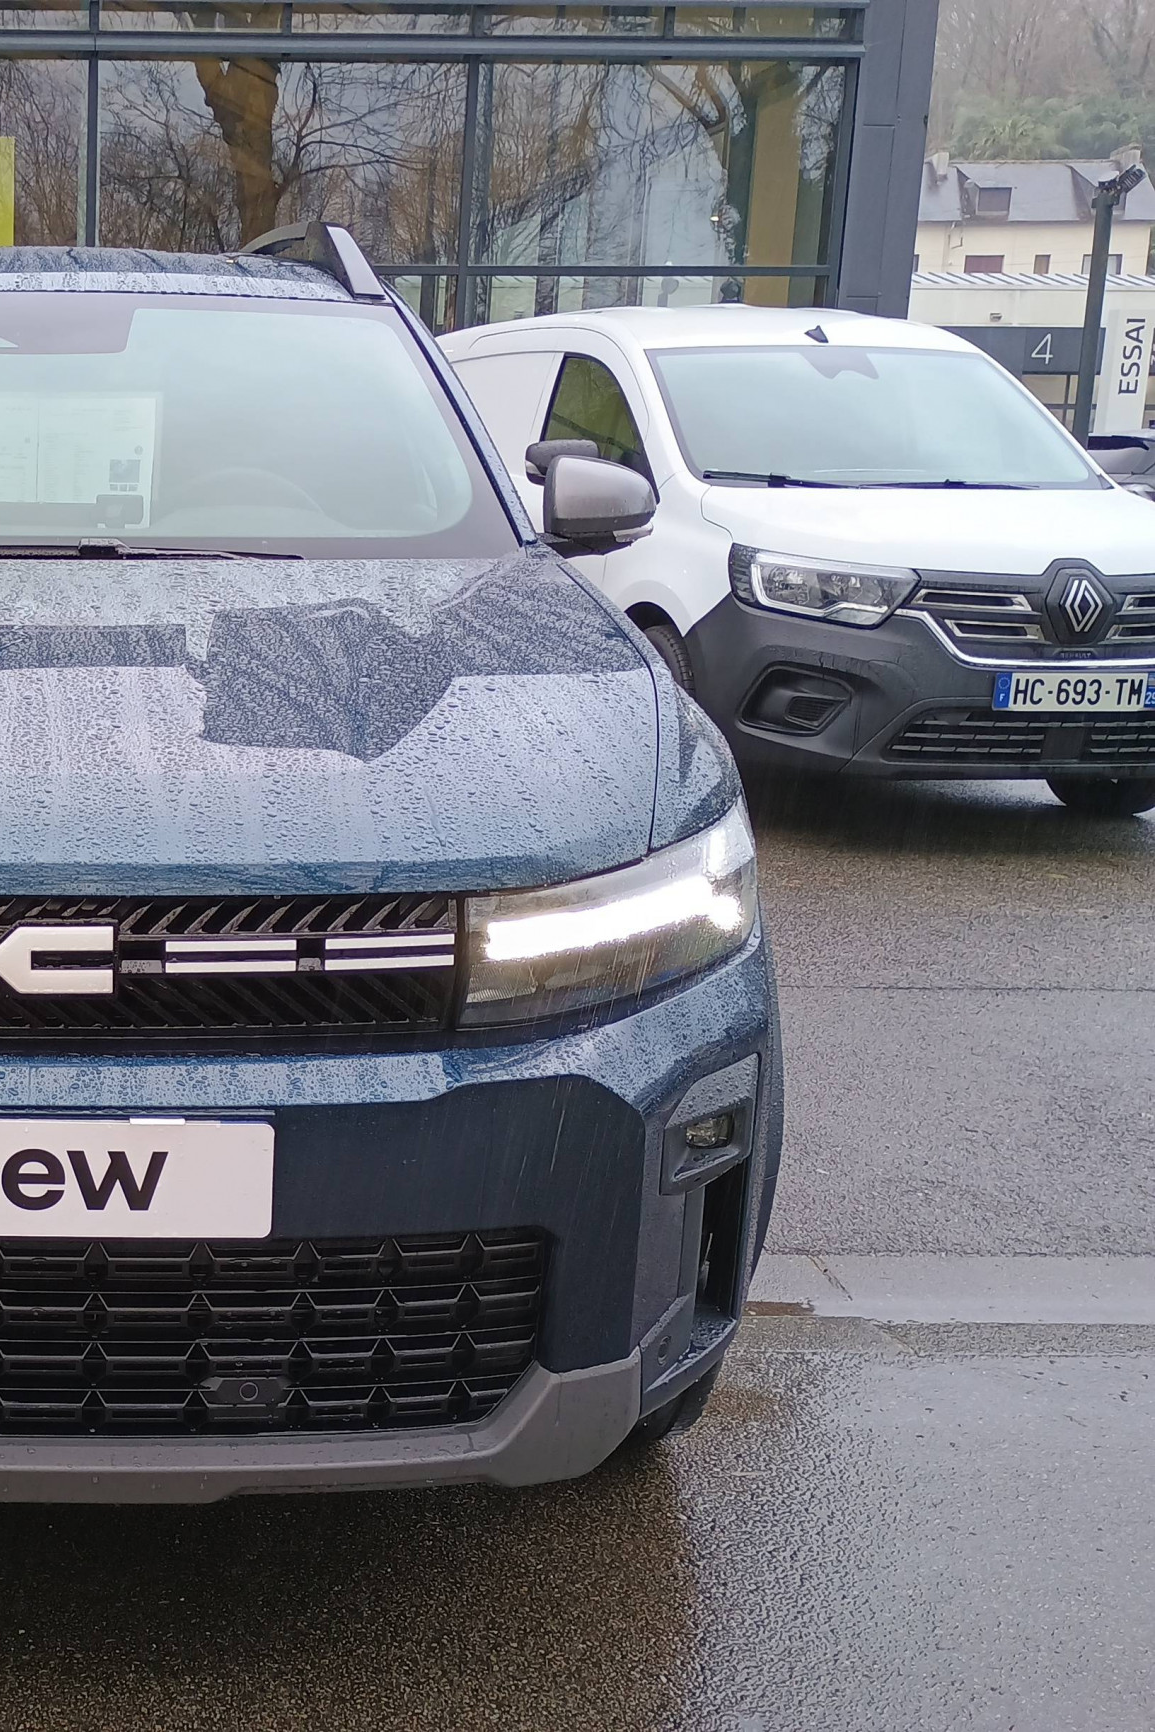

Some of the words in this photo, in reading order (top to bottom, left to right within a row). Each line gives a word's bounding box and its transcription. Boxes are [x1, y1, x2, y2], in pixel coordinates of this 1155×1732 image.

[1031, 332, 1054, 365] 4
[1118, 317, 1147, 395] ESSAI
[999, 693, 1006, 702] F
[1013, 677, 1144, 706] HC-693-TM
